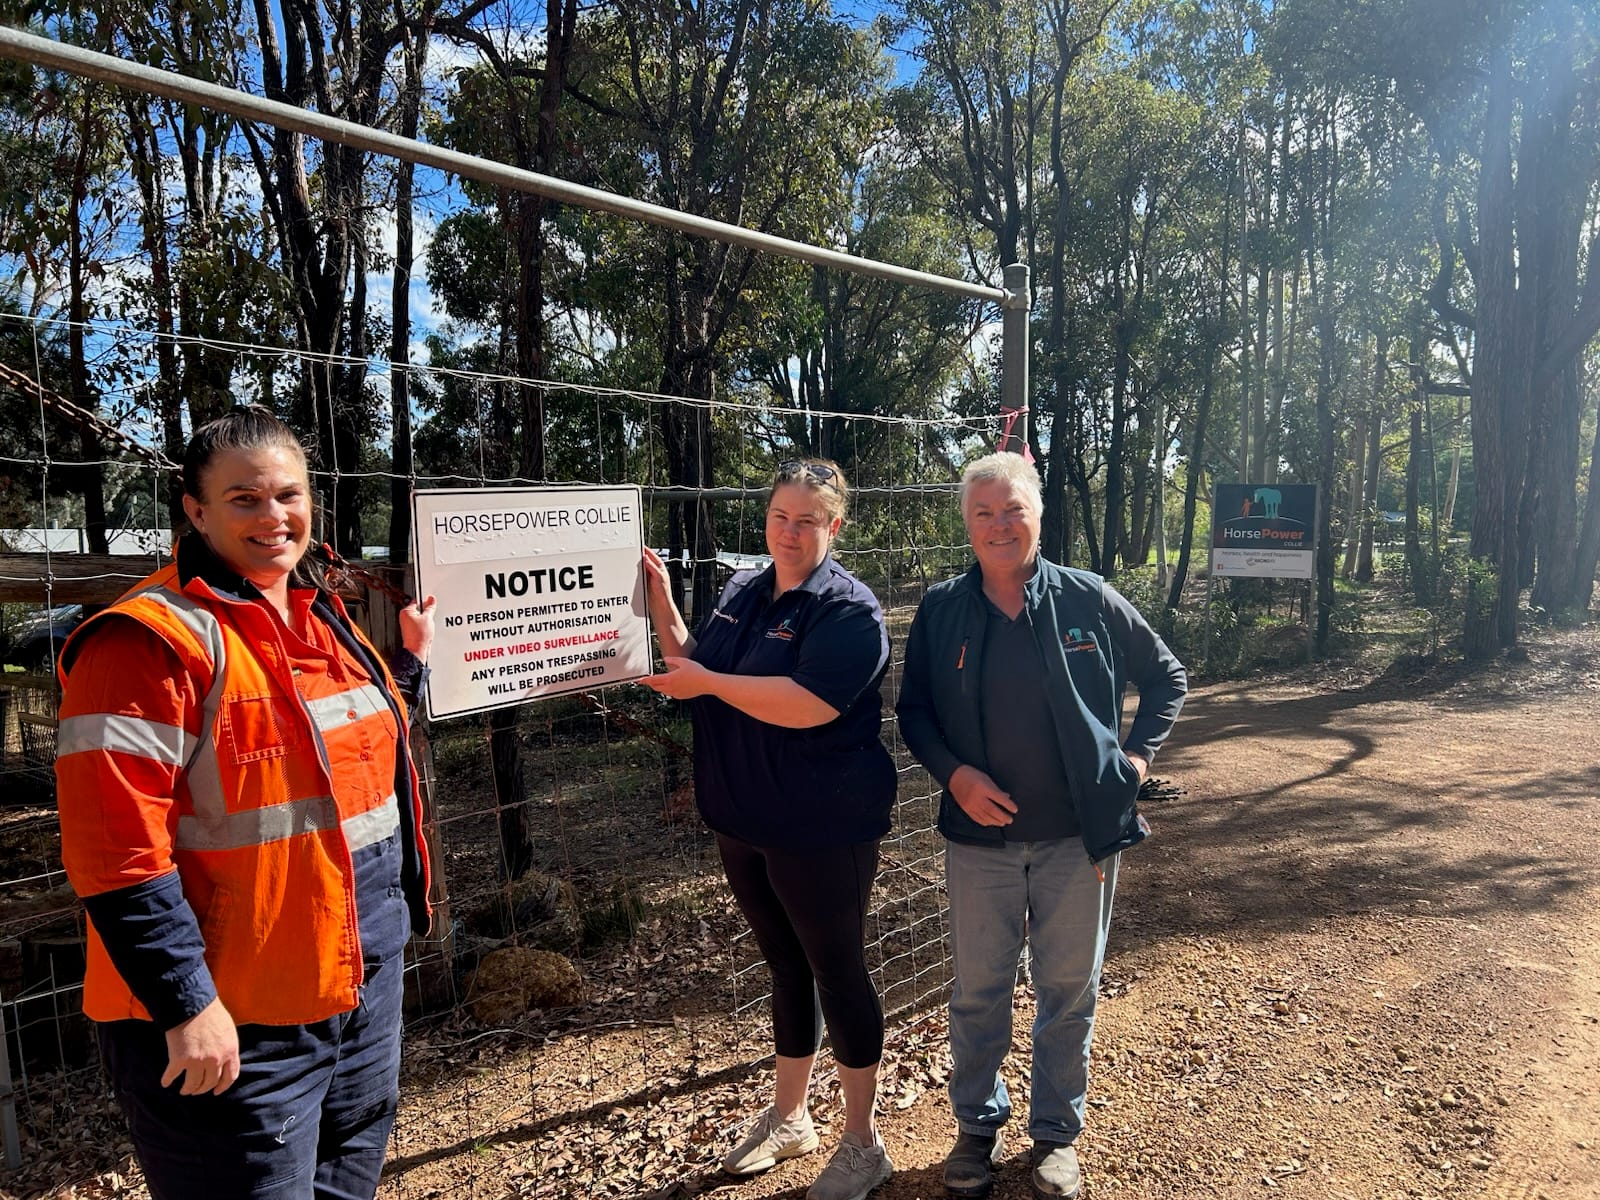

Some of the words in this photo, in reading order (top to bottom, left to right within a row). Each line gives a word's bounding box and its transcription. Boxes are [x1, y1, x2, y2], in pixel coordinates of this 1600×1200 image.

[434, 510, 570, 535] HORSEPOWER
[575, 506, 631, 525] COLLIE
[1223, 527, 1305, 540] HorsePower
[485, 565, 594, 599] NOTICE
[445, 615, 463, 627] NO
[467, 609, 514, 624] PERSON
[518, 602, 578, 618] PERMITTED
[580, 600, 594, 610] TO
[596, 596, 629, 608] ENTER
[470, 625, 525, 641] WITHOUT
[528, 613, 612, 634] AUTHORISATION
[464, 647, 504, 662] UNDER
[507, 642, 541, 655] VIDEO
[544, 630, 620, 650] SURVEILLANCE
[471, 668, 495, 681] ANY
[499, 660, 544, 676] PERSON
[547, 648, 616, 668] TRESPASSING
[488, 683, 516, 695] WILL
[519, 680, 534, 690] BE
[536, 666, 605, 687] PROSECUTED
